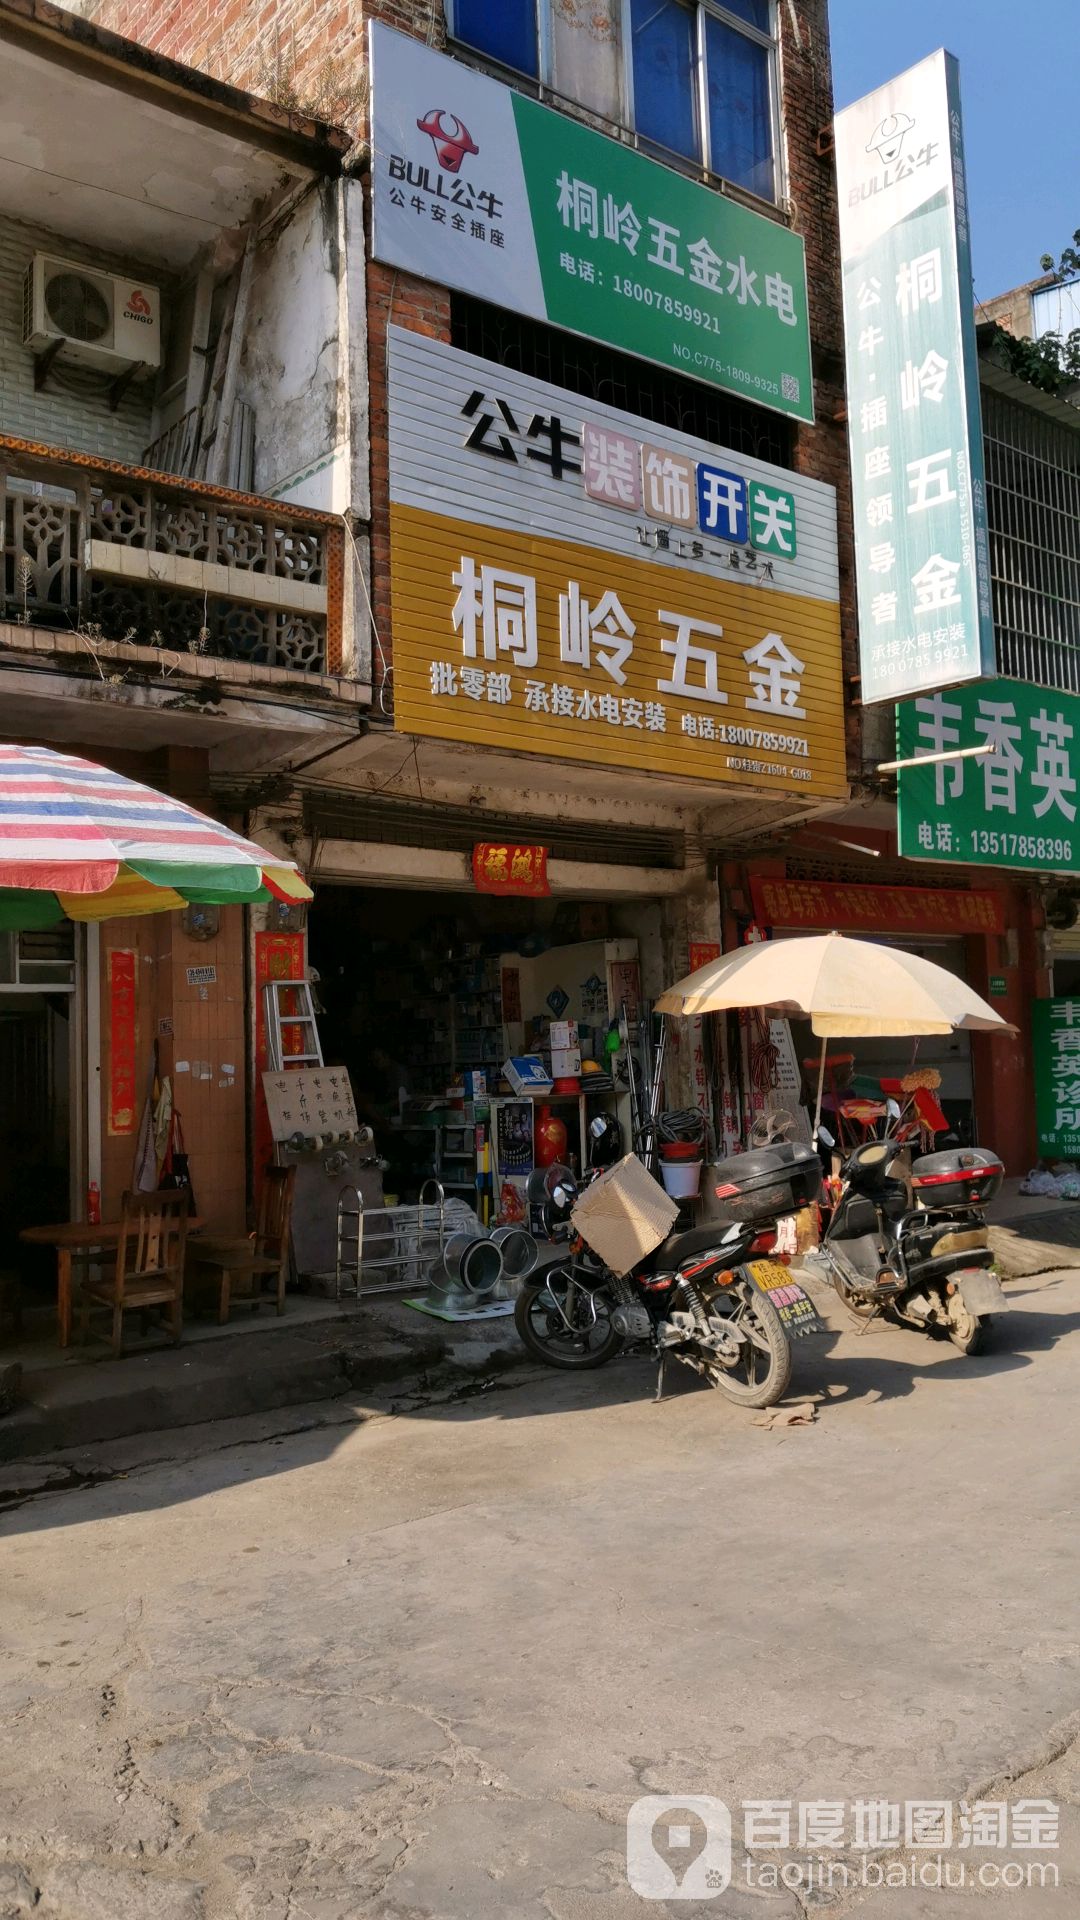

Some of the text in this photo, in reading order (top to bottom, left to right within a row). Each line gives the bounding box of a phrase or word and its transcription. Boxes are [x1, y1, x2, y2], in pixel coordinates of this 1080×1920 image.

[389, 154, 503, 219] BULL公牛
[848, 142, 939, 208] BULL公牛
[389, 187, 505, 249] 公牛安全插座
[556, 170, 798, 327] 桐岭五金水电
[123, 310, 154, 326] CHIGO
[673, 343, 779, 396] NO.C775-1809-9325
[895, 248, 962, 614] 桐岭五金
[461, 391, 793, 552] 公牛装饰开关
[451, 556, 807, 719] 桐岭五金
[871, 622, 966, 662] 承接水电安装
[430, 661, 511, 704] 批零部
[525, 679, 667, 733] 承接水电安装
[914, 697, 1078, 822] 韦香英
